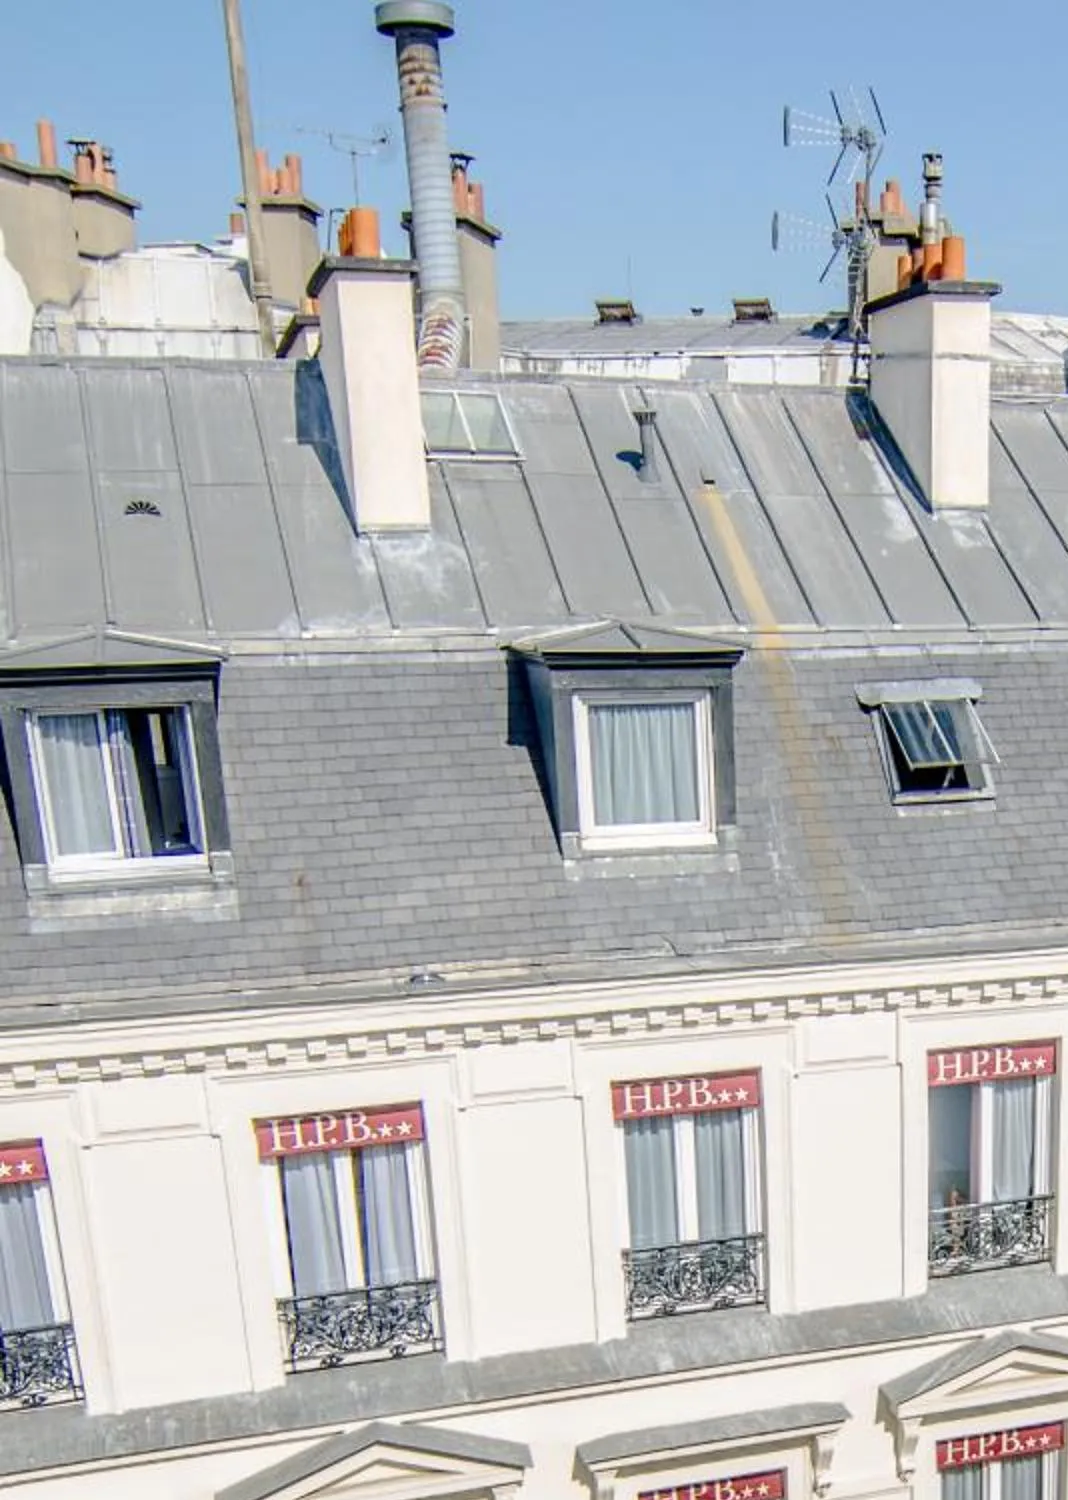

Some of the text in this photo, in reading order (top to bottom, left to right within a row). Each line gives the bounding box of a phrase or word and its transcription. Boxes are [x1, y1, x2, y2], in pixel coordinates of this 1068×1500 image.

[935, 1047, 1018, 1081] H.P.B.
[622, 1078, 718, 1114] H.P.B.
[271, 1111, 378, 1151] H.P.B.
[944, 1432, 1026, 1464] H.P.B.
